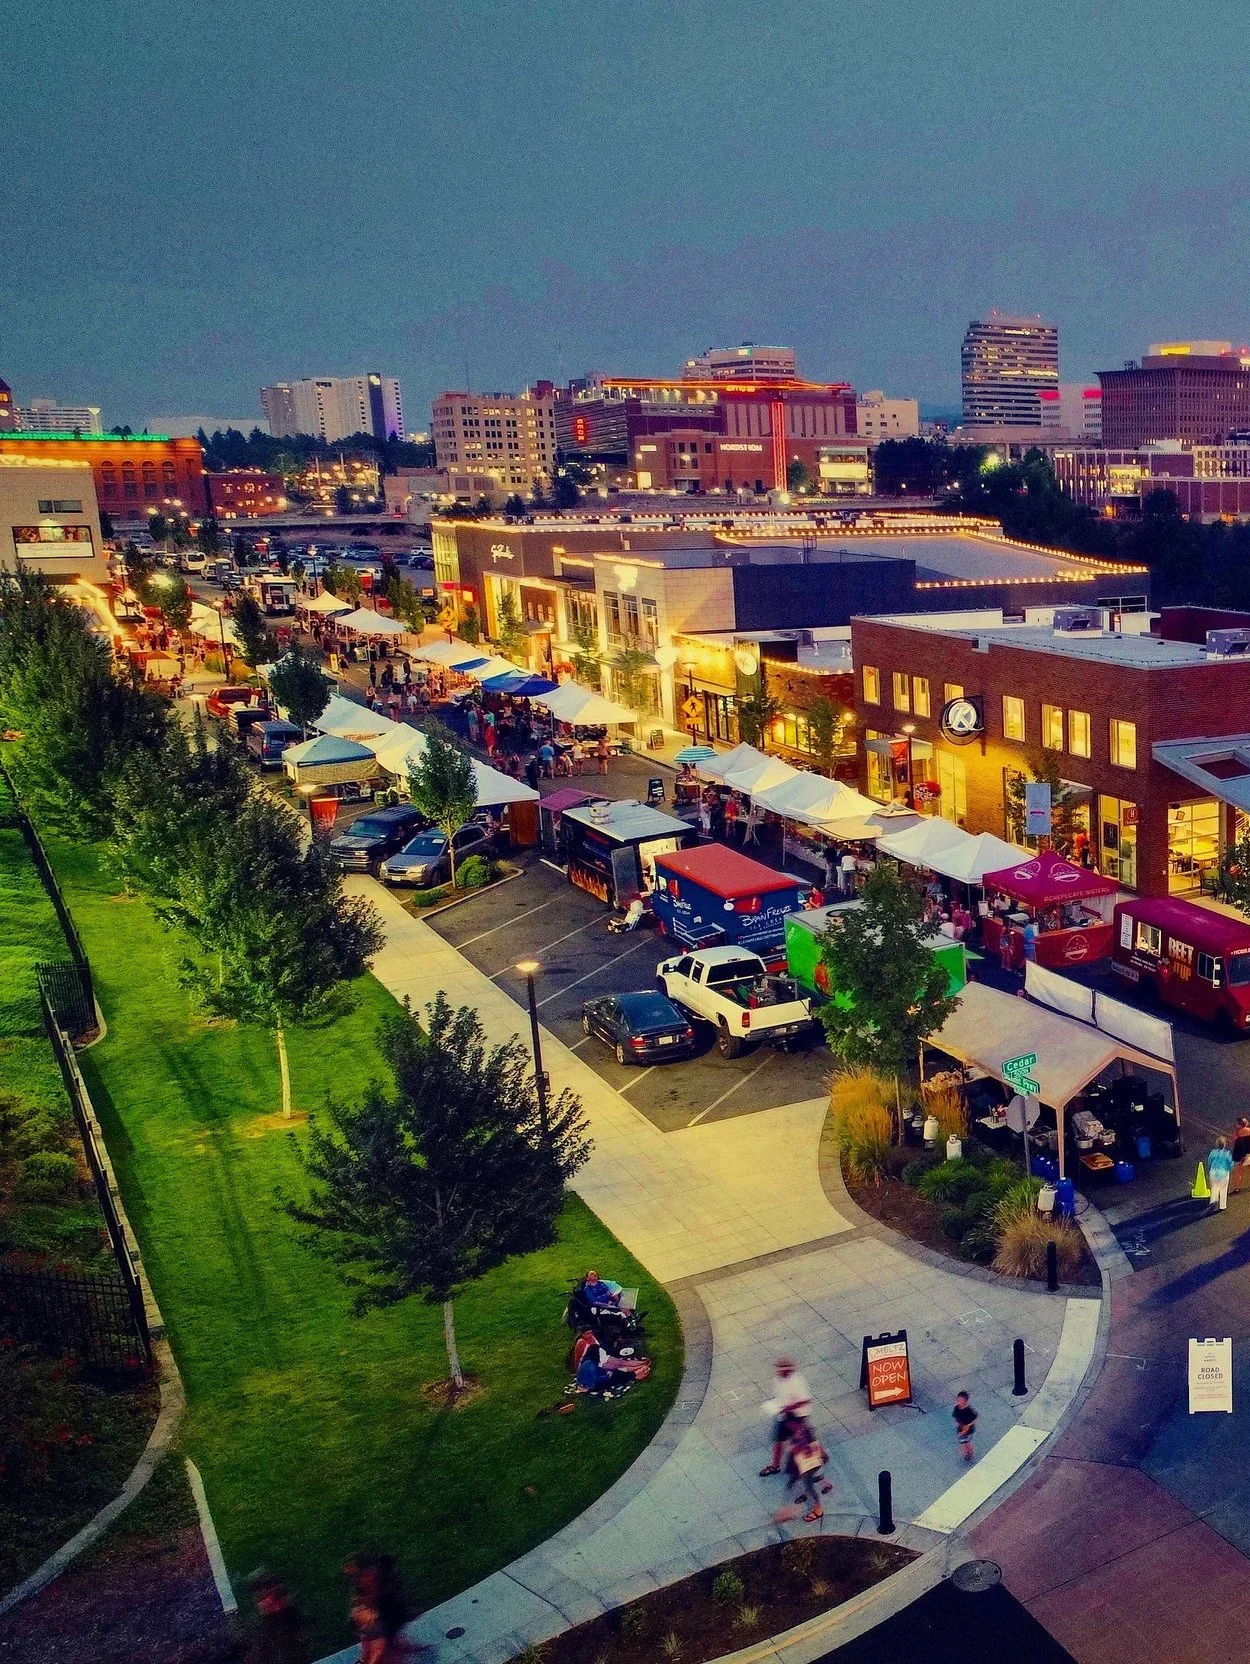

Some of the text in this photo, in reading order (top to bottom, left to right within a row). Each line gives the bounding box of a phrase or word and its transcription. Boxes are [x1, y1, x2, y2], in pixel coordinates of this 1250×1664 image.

[720, 443, 763, 452] NORDSTROM
[1169, 936, 1194, 965] BEET
[1007, 1056, 1034, 1071] Cedar
[875, 1343, 906, 1355] MELTZ
[872, 1359, 905, 1375] NOW
[871, 1371, 906, 1387] OPEN
